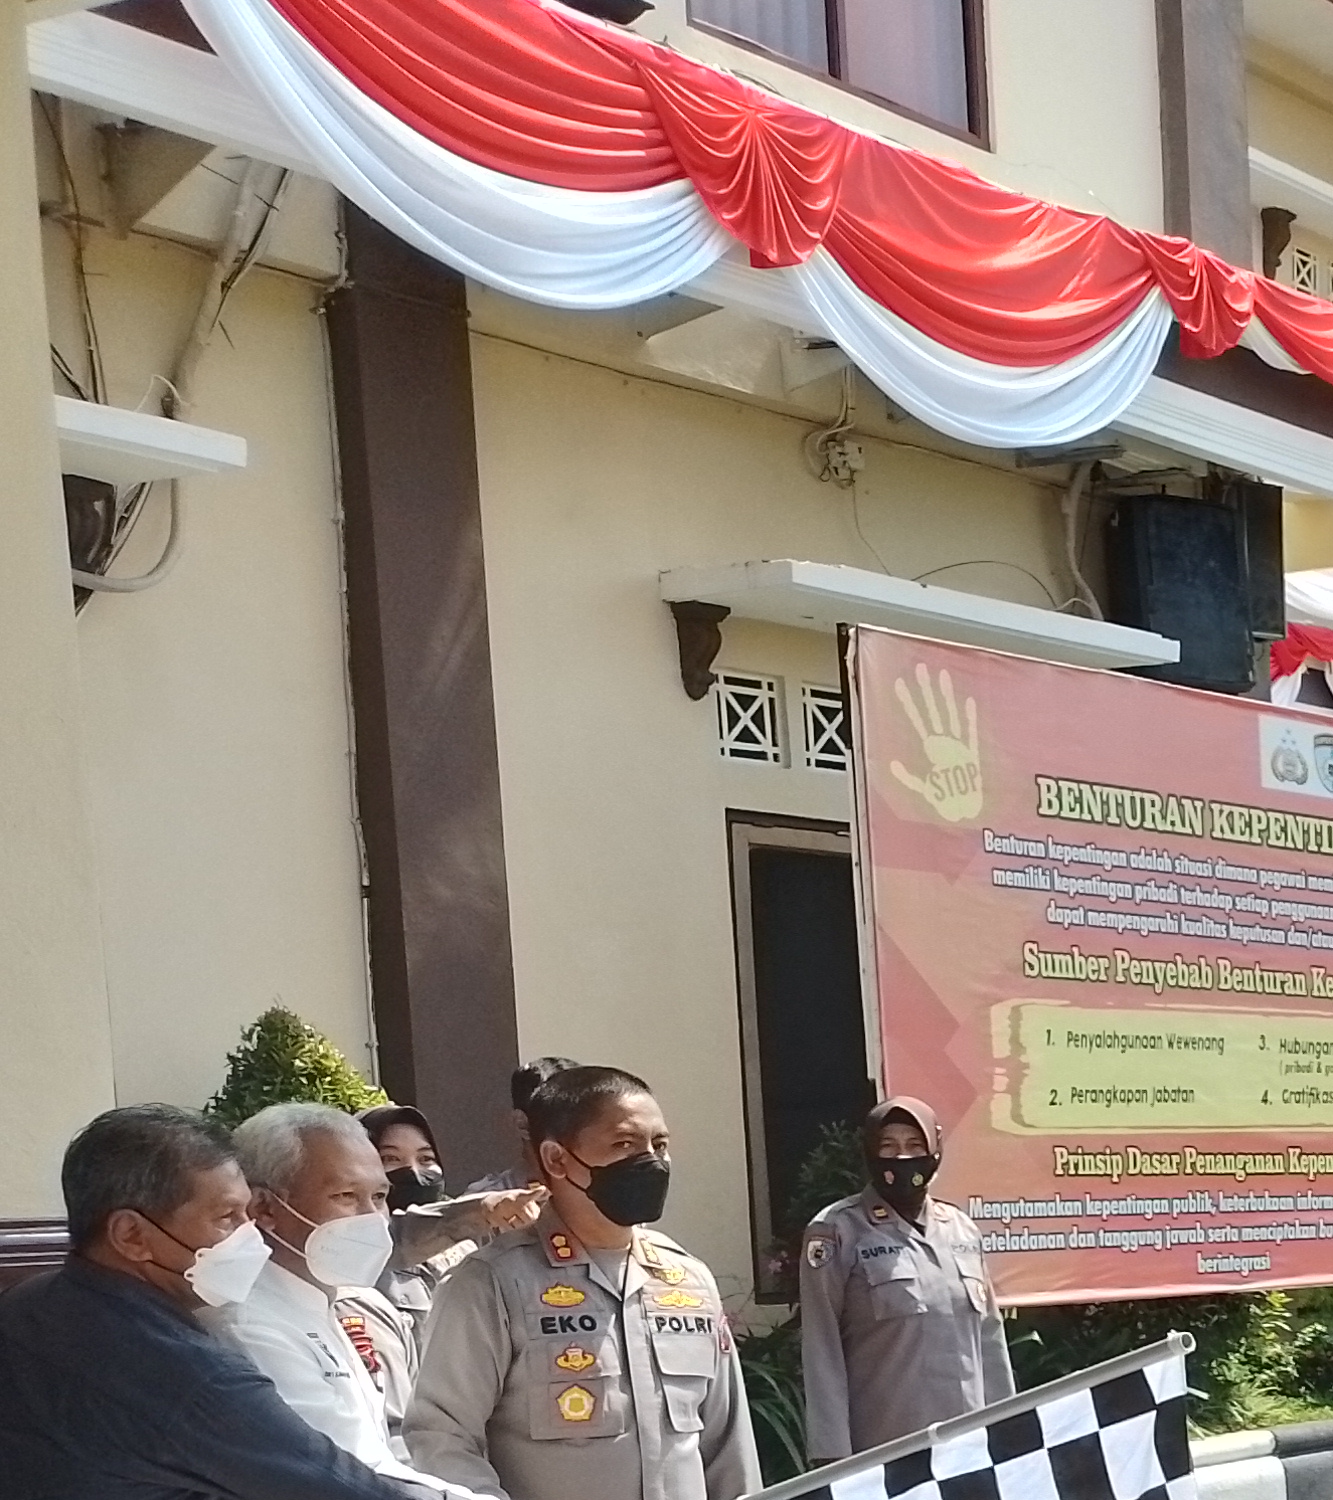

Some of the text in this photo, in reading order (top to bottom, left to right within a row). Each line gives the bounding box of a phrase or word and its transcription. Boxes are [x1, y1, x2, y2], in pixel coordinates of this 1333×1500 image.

[929, 761, 978, 802] STOP
[1035, 774, 1204, 837] BENTURAN
[983, 828, 1046, 858] Benturan
[1048, 835, 1128, 871] kepentingan
[1129, 846, 1173, 873] adalah
[1174, 848, 1213, 877] situasi
[1215, 856, 1257, 884] dimana
[1259, 868, 1306, 891] pegawai
[992, 865, 1051, 889] memiliki
[1053, 867, 1132, 903] kepentingan
[1134, 879, 1178, 905] pribadi
[1180, 884, 1233, 913] terhadap
[1235, 892, 1269, 918] setiap
[1047, 900, 1085, 930] dapat
[1087, 908, 1179, 938] mempengaruhi
[1180, 912, 1227, 940] kualitas
[1229, 918, 1286, 946] keputusan
[1023, 941, 1110, 983] Sumber
[1113, 948, 1214, 995] Penyebab
[1217, 957, 1307, 997] Benturan
[1046, 1029, 1225, 1055] 1. Penyalahgunaan Wewenang
[1258, 1034, 1270, 1051] 3.
[1049, 1089, 1062, 1106] 2.
[1070, 1086, 1148, 1108] Perangkapan
[1261, 1089, 1272, 1105] 4.
[1053, 1145, 1123, 1184] Prinsip
[1126, 1146, 1181, 1177] Dasar
[1183, 1146, 1286, 1183] Penanganan
[968, 1192, 1083, 1223] Mengutamakan
[1085, 1192, 1170, 1222] kepentingan
[1172, 1190, 1217, 1217] publik,
[1219, 1189, 1294, 1213] keterbukaan
[981, 1226, 1066, 1252] eteladanan
[1068, 1224, 1096, 1249] dan
[1098, 1228, 1163, 1252] tanggung
[1165, 1221, 1205, 1248] jawab
[1207, 1222, 1239, 1244] serta
[1241, 1217, 1317, 1246] menciptakan
[1196, 1250, 1272, 1277] berintegrasi
[540, 1314, 597, 1334] EKO
[655, 1315, 713, 1334] POLRI
